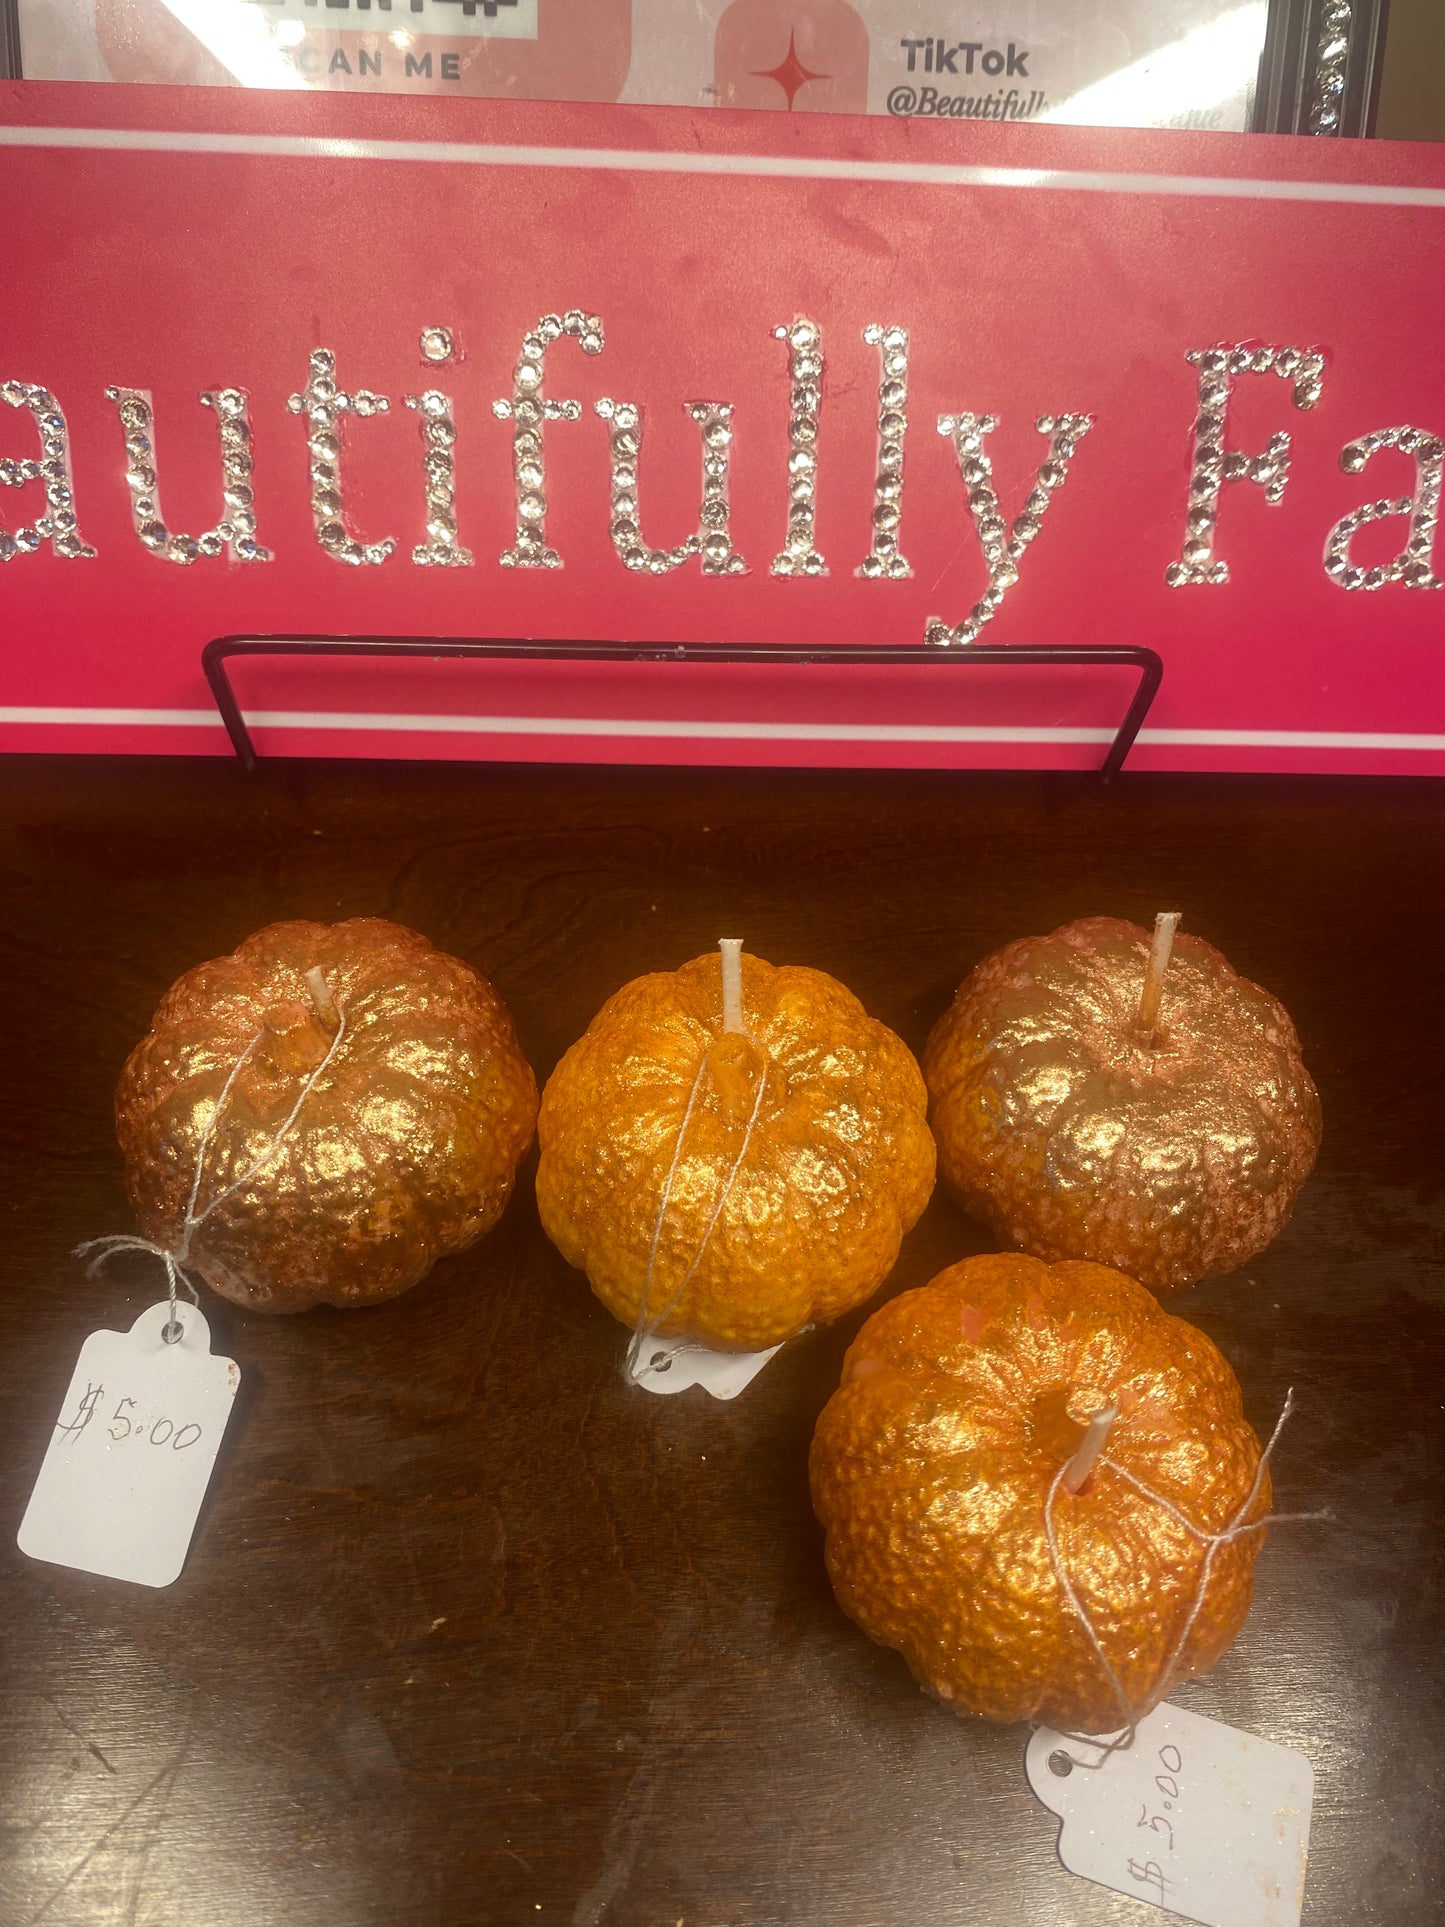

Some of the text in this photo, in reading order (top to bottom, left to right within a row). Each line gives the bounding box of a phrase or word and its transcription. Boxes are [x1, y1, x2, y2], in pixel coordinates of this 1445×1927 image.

[281, 46, 461, 80] CAN ME
[900, 37, 1029, 77] TikTok
